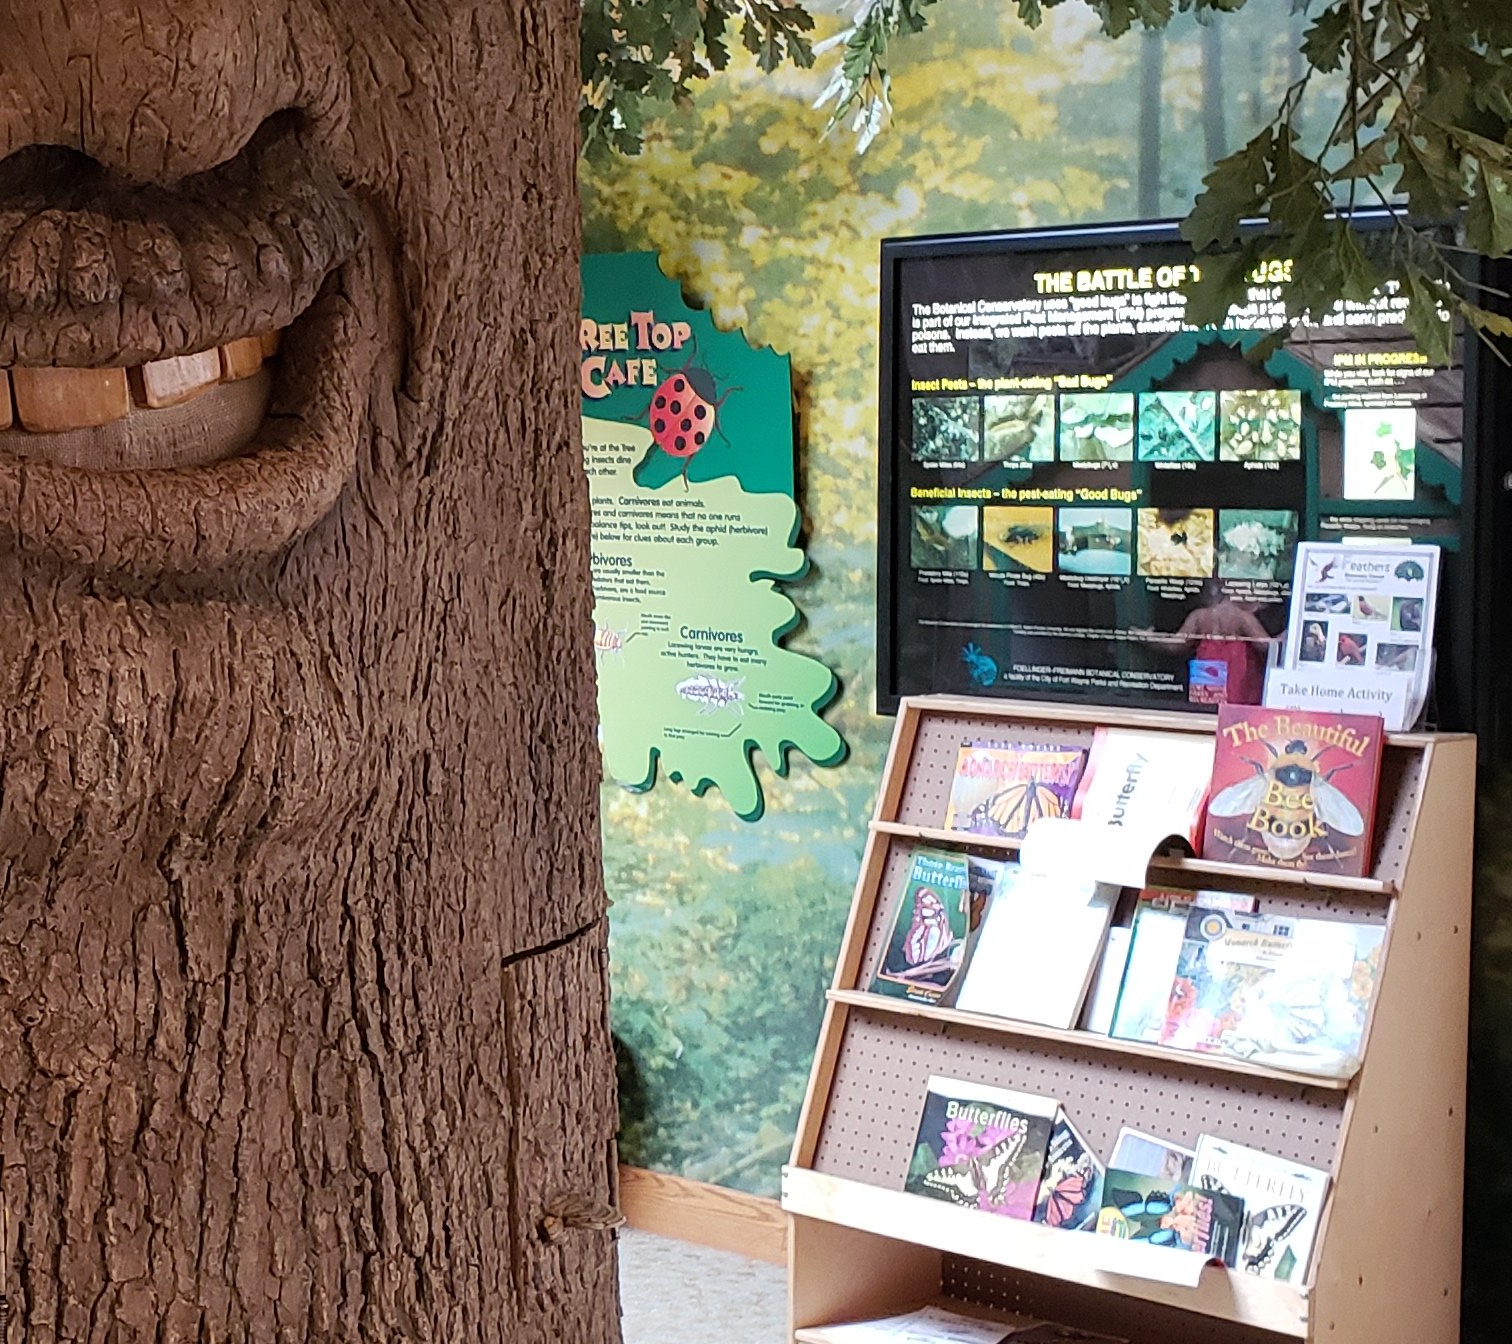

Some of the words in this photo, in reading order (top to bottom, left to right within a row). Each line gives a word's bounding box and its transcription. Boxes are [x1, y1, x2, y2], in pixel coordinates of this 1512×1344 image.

[1033, 272, 1074, 294] THE
[1076, 268, 1152, 293] BATTLE
[1156, 265, 1187, 288] OF
[912, 303, 931, 316] The
[932, 301, 976, 315] Botanical
[977, 299, 1042, 313] Conservatory
[1043, 298, 1068, 310] uses
[922, 316, 942, 331] part
[942, 315, 953, 327] of
[954, 316, 971, 327] our
[972, 313, 1022, 328] Integrated
[580, 317, 629, 351] REE
[955, 327, 993, 340] Instead,
[912, 342, 928, 354] eat
[928, 341, 955, 353] them.
[580, 355, 658, 399] CAFE
[911, 378, 940, 391] Insect
[941, 377, 968, 391] Pests
[977, 377, 993, 390] the
[994, 376, 1053, 391] plant-eating
[608, 443, 620, 453] the
[621, 443, 636, 453] Tree
[616, 455, 632, 465] dine
[618, 496, 661, 507] Carnivores
[662, 499, 674, 507] eat
[910, 487, 956, 499] Beneficial
[957, 487, 992, 500] Insects
[1001, 487, 1017, 499] the
[1018, 488, 1074, 503] pest-eating
[1075, 487, 1109, 501] "Good
[1110, 488, 1143, 503] Bugs"
[603, 509, 617, 518] and
[618, 510, 653, 519] carnivores
[681, 512, 696, 520] that
[635, 521, 651, 530] look
[670, 523, 689, 535] Study
[692, 524, 704, 532] the
[706, 525, 727, 535] aphid
[728, 525, 769, 537] (herbivore)
[599, 533, 621, 543] below
[622, 533, 633, 542] for
[634, 533, 652, 543] clues
[654, 535, 674, 543] about
[676, 536, 694, 545] each
[592, 552, 633, 568] bivores
[680, 625, 744, 643] Carnivores
[703, 652, 717, 662] They
[1280, 683, 1309, 696] Take
[1311, 684, 1345, 699] Home
[1347, 687, 1393, 704] Activity
[1222, 721, 1269, 748] The
[1273, 714, 1371, 758] Beautiful
[1263, 780, 1315, 809] Bee
[1247, 806, 1329, 841] Book
[913, 866, 968, 889] Butterfl
[945, 1100, 1029, 1134] Butterflies
[1191, 1197, 1214, 1254] erflies!
